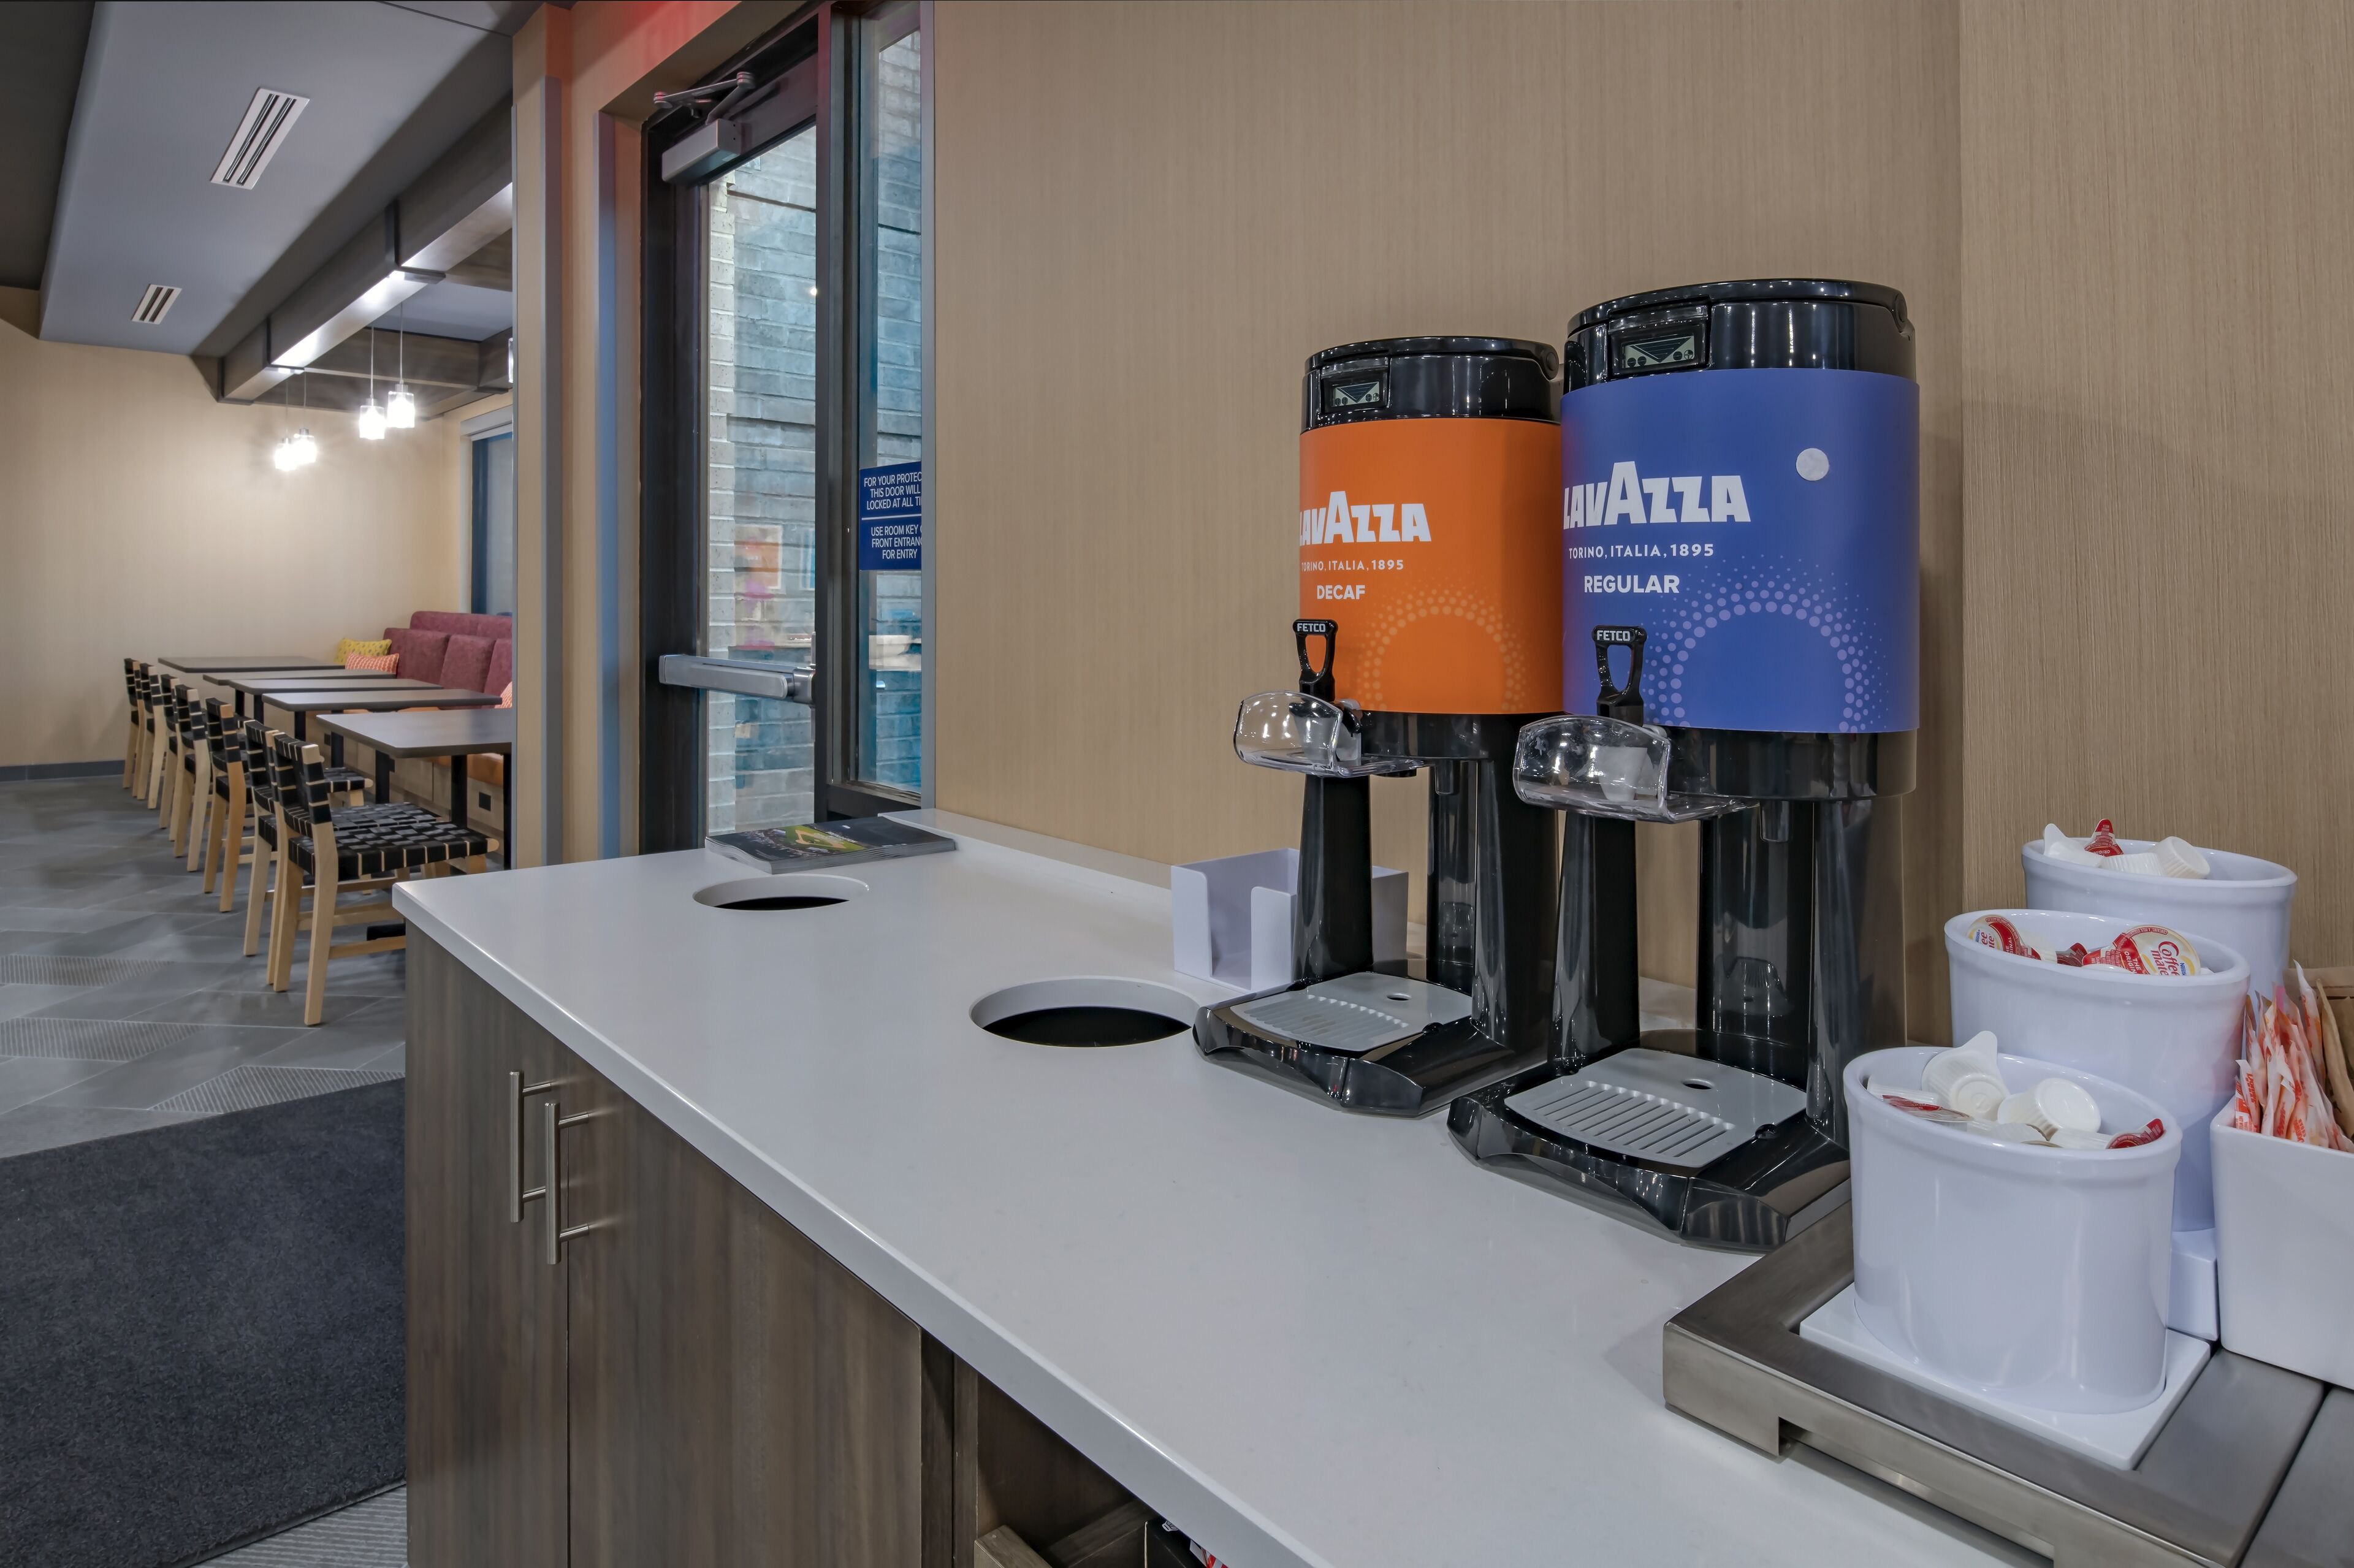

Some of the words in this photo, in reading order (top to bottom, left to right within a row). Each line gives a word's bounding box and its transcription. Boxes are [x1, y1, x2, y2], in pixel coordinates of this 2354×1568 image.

[864, 477, 877, 487] FOR
[878, 474, 895, 485] YOUR
[870, 488, 884, 498] THIS
[885, 486, 904, 497] DOOR
[905, 485, 921, 495] WILL
[1563, 461, 1751, 530] LAVAZZA
[867, 498, 891, 510] LOCKED
[893, 498, 901, 508] AT
[902, 497, 913, 507] ALL
[871, 527, 883, 536] USE
[885, 525, 904, 536] ROOM
[905, 524, 919, 535] KEY
[872, 538, 893, 548] FRONT
[882, 550, 895, 560] FOR
[896, 549, 918, 559] ENTRY
[1569, 546, 1608, 560] TORINO,
[1611, 544, 1667, 558] ITALIA,
[1670, 544, 1714, 557] 1895
[1301, 560, 1327, 572] TORINO,
[1328, 559, 1369, 571] ITALIA,
[1371, 559, 1404, 570] 1895
[1584, 575, 1680, 593] REGULAR
[1317, 585, 1366, 600] DECAF
[1297, 623, 1326, 633] FETCO
[1596, 630, 1631, 641] FETCO
[2132, 957, 2142, 971] THE
